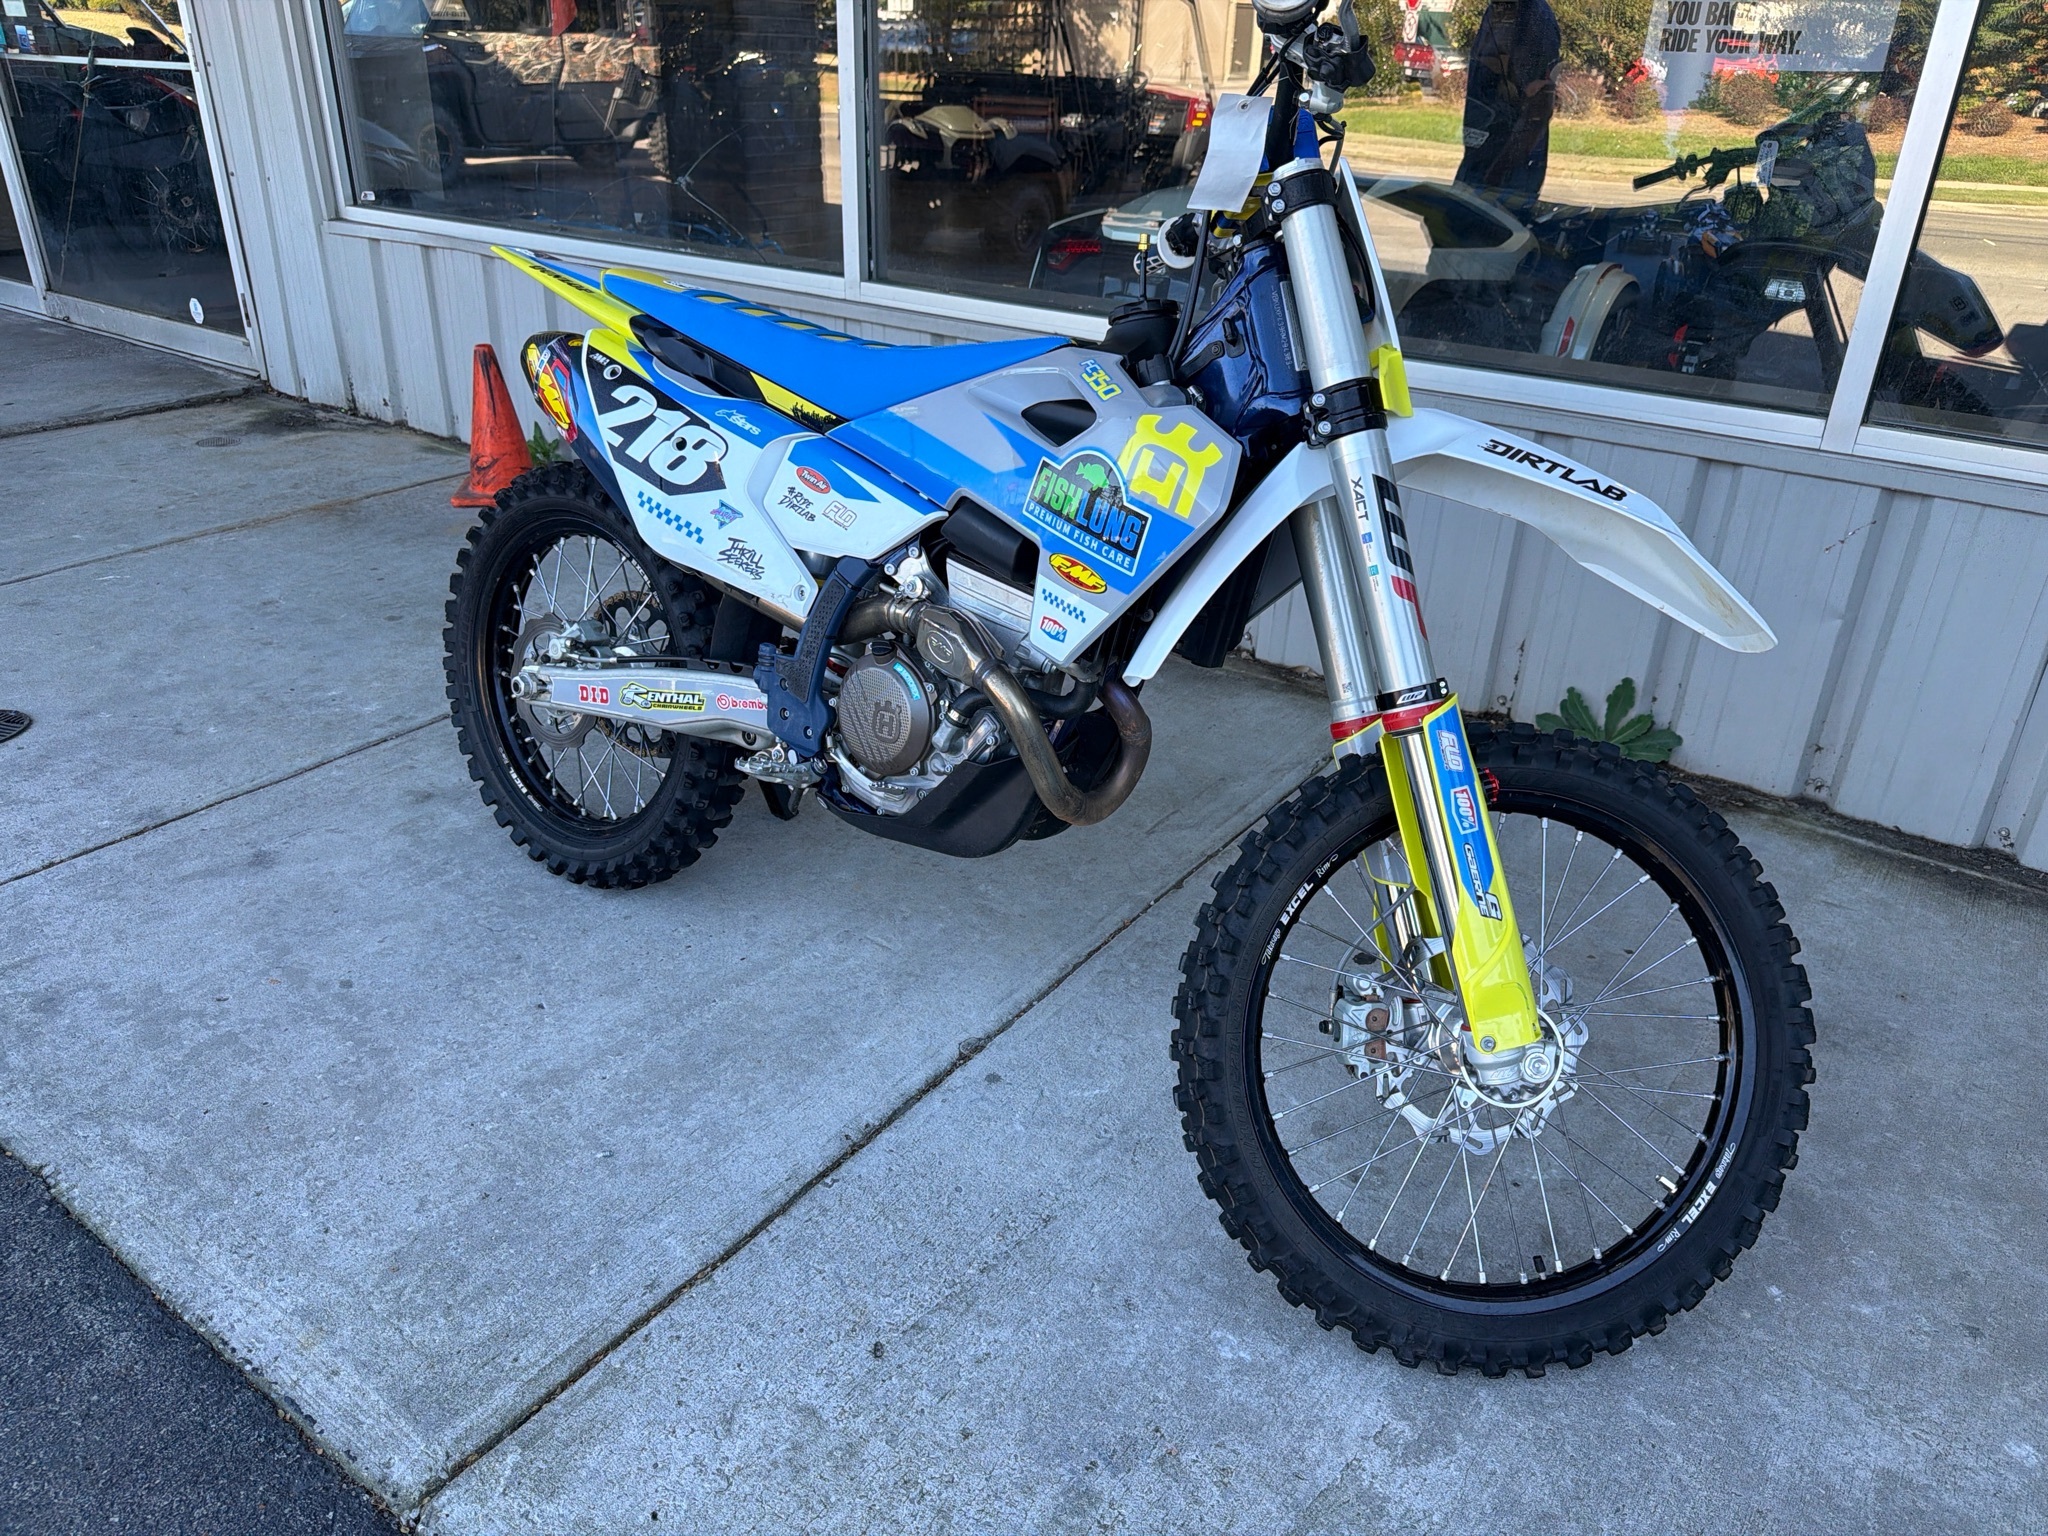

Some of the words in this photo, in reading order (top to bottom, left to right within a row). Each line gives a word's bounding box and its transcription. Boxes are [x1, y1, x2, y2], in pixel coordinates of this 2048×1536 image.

[1666, 1, 1701, 25] YOU
[1658, 28, 1701, 52] RIDE
[1705, 29, 1752, 54] YOUR
[1080, 360, 1122, 401] FC350
[600, 385, 728, 486] 218
[801, 469, 817, 483] Twin
[814, 479, 828, 492] Air
[1478, 439, 1628, 501] DIRTLAB
[778, 495, 816, 522] DIRTLAB
[787, 487, 813, 509] #RIDE
[1351, 476, 1369, 521] XACT
[1028, 503, 1070, 535] PREMIUM
[1073, 530, 1098, 551] FISH
[1101, 548, 1131, 568] CARE
[717, 550, 765, 581] SEEKERS
[728, 537, 765, 570] THRILL
[1052, 556, 1106, 589] FMF
[1041, 617, 1066, 641] 100%
[652, 703, 702, 711] CHAINWHEELS
[1454, 790, 1476, 830] 100%
[1280, 882, 1314, 926] EXCEL
[1681, 1181, 1717, 1226] EXCEL
